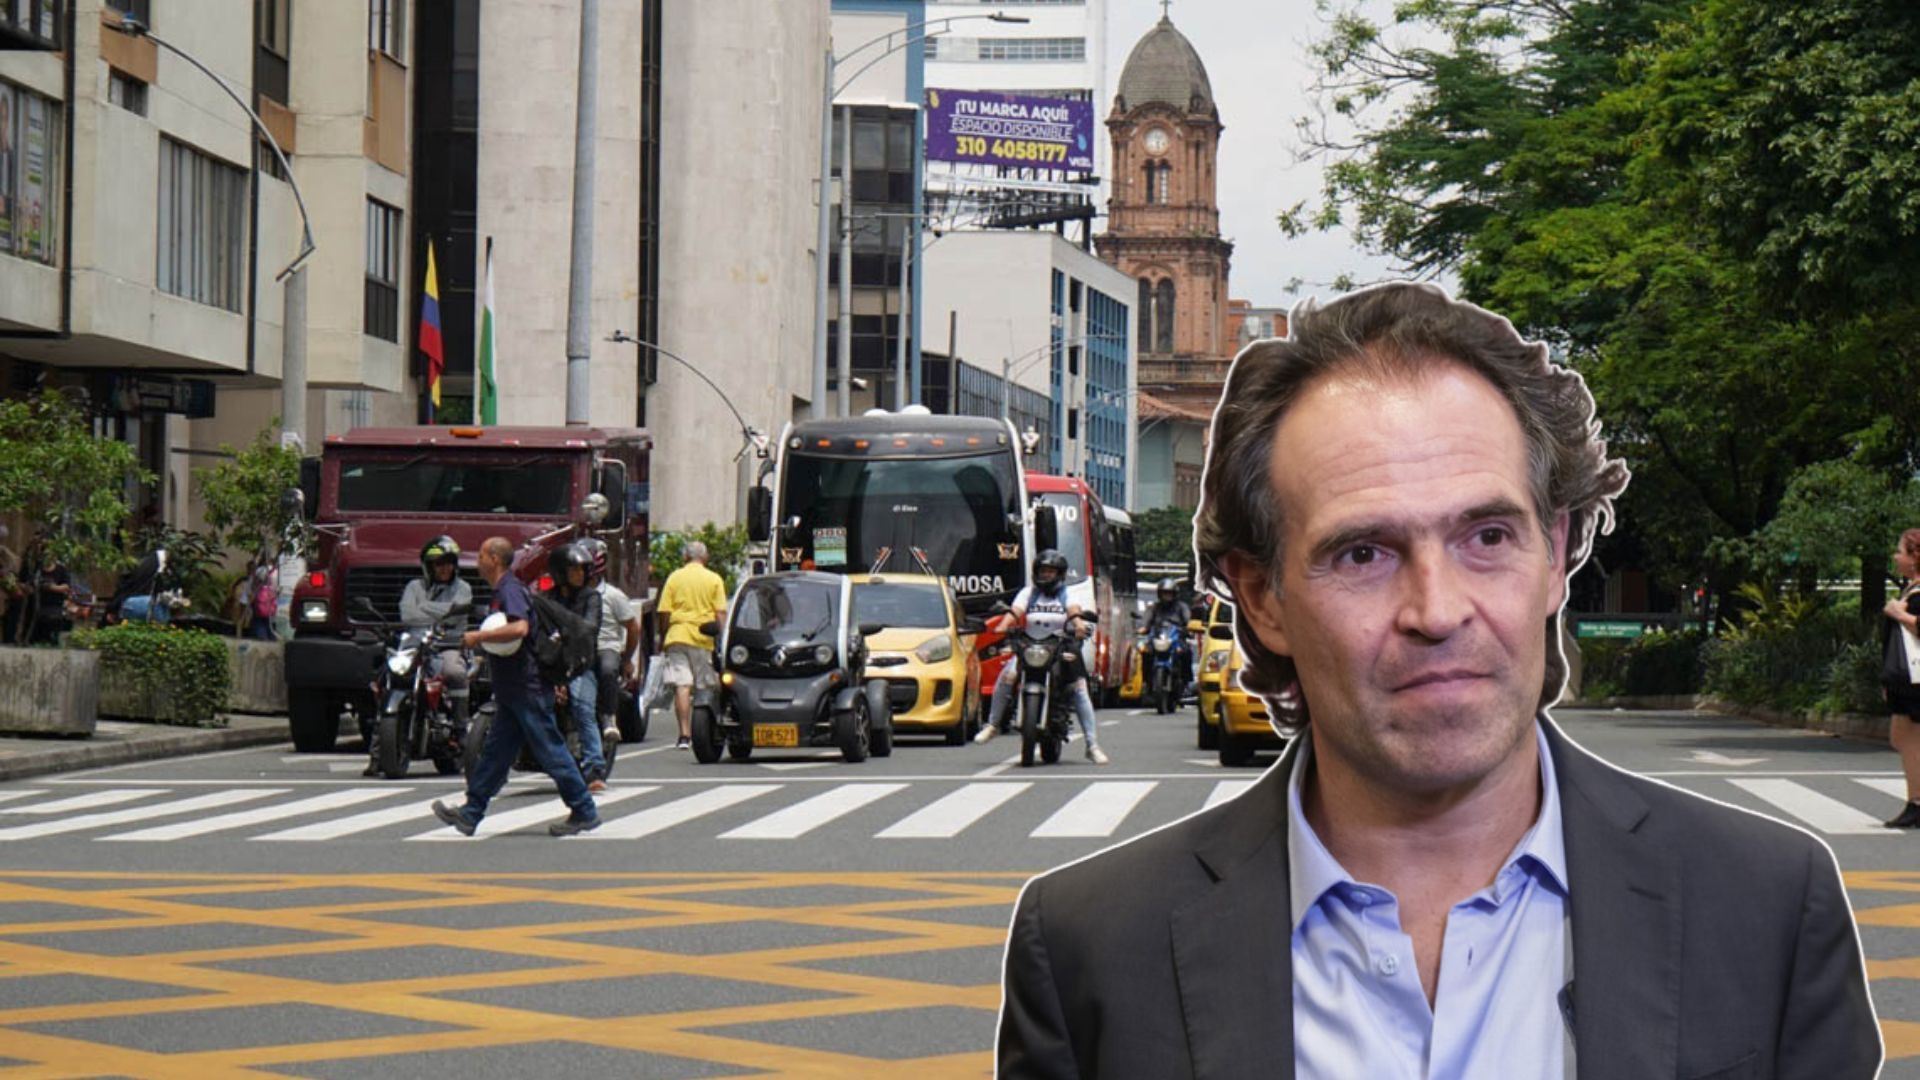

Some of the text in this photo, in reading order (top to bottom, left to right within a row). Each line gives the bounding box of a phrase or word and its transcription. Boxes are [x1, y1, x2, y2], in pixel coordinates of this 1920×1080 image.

[955, 99, 977, 114] ¡TU
[980, 102, 1028, 119] MARCA
[952, 117, 1073, 141] ESPACIO DISPONIBLE
[956, 136, 987, 156] 310
[991, 139, 1068, 162] 4058177
